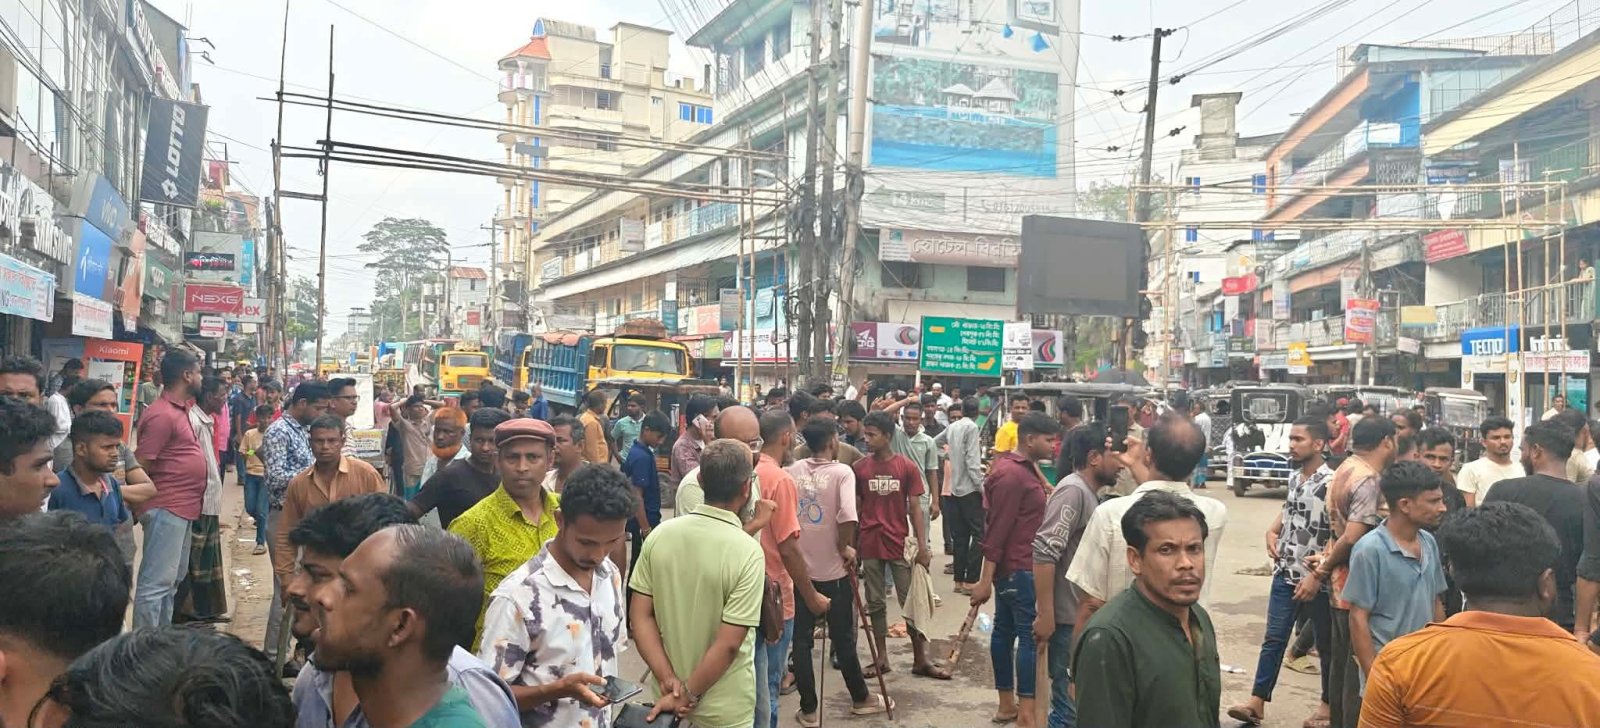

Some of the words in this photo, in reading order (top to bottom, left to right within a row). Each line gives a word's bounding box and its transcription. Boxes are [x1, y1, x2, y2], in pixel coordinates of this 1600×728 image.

[166, 104, 186, 177] LOTTO
[99, 345, 129, 355] Xiaomi
[1469, 338, 1504, 355] TECNO
[1530, 334, 1571, 352] Infnix
